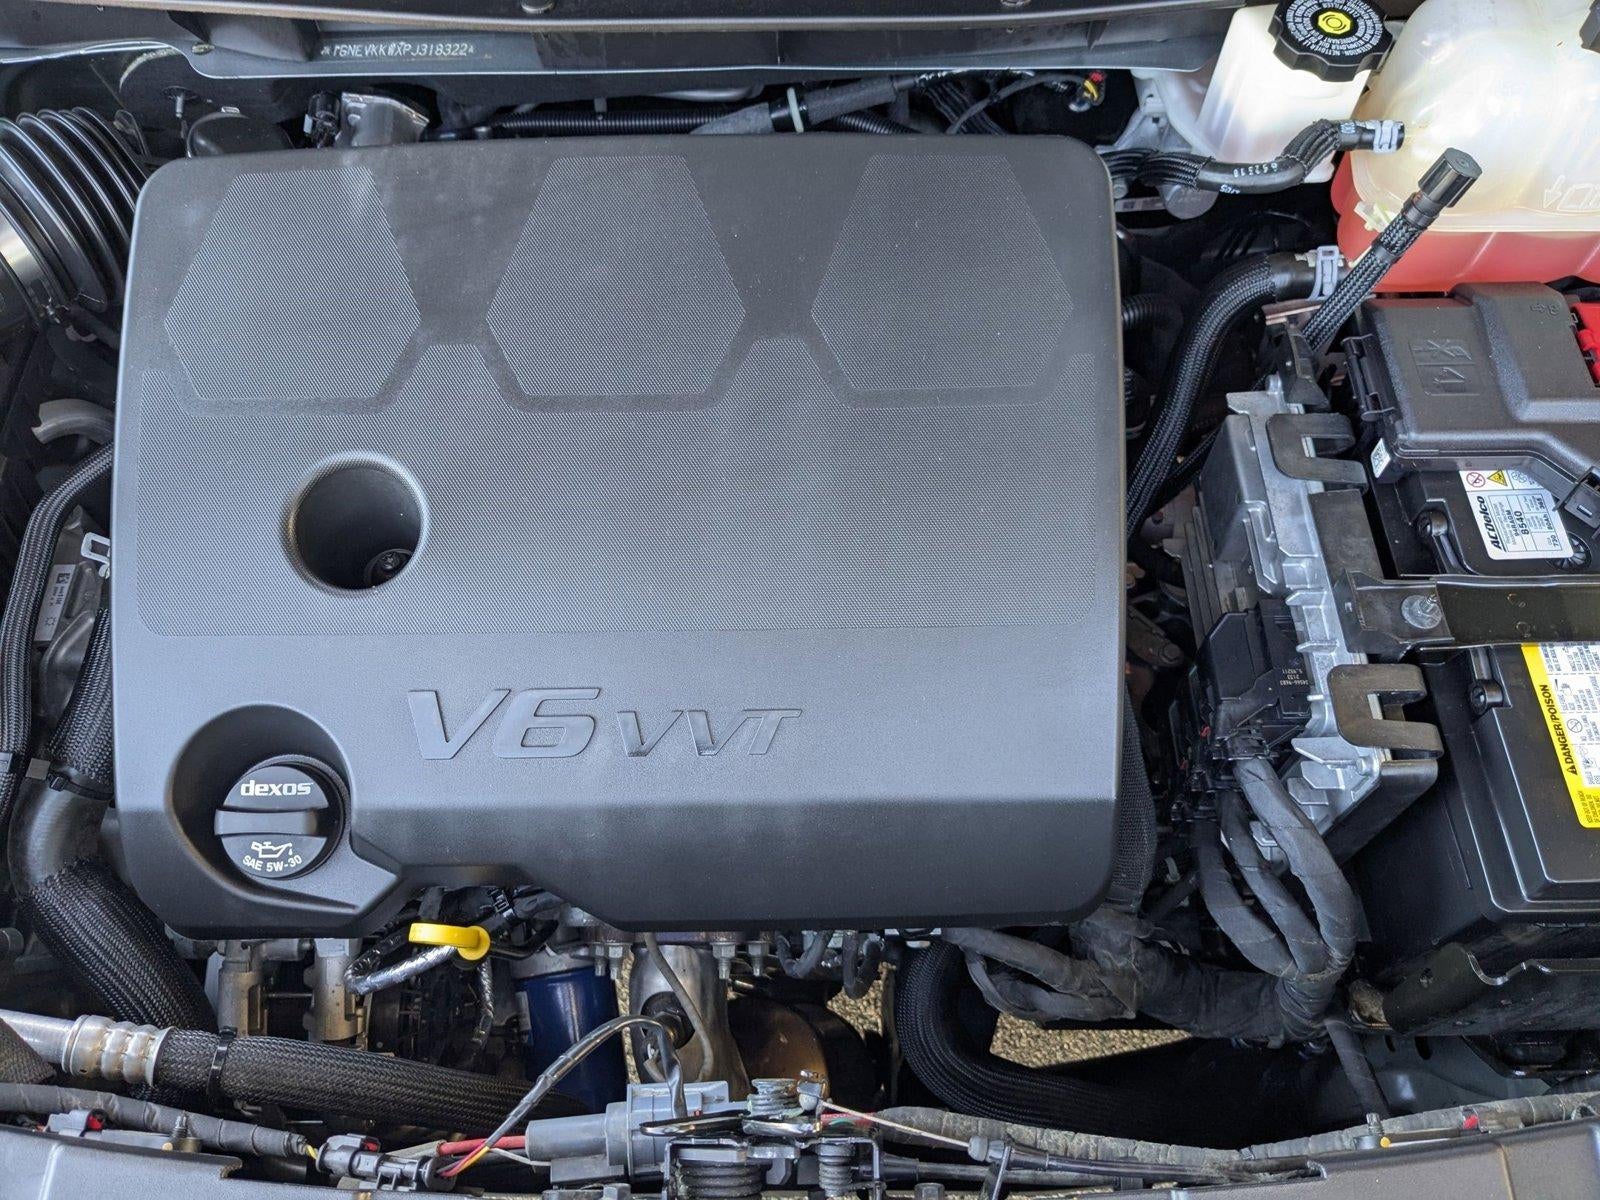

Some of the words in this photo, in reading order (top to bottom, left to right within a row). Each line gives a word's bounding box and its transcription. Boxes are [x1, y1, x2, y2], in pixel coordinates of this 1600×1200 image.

[1476, 495, 1502, 550] ACDelco
[1514, 510, 1529, 534] 8540
[407, 687, 601, 760] V6
[617, 709, 802, 757] VVT
[1540, 684, 1573, 763] DANGER/POISON
[241, 780, 314, 796] dexos
[243, 855, 263, 871] SAE
[266, 855, 302, 872] 5W-30
